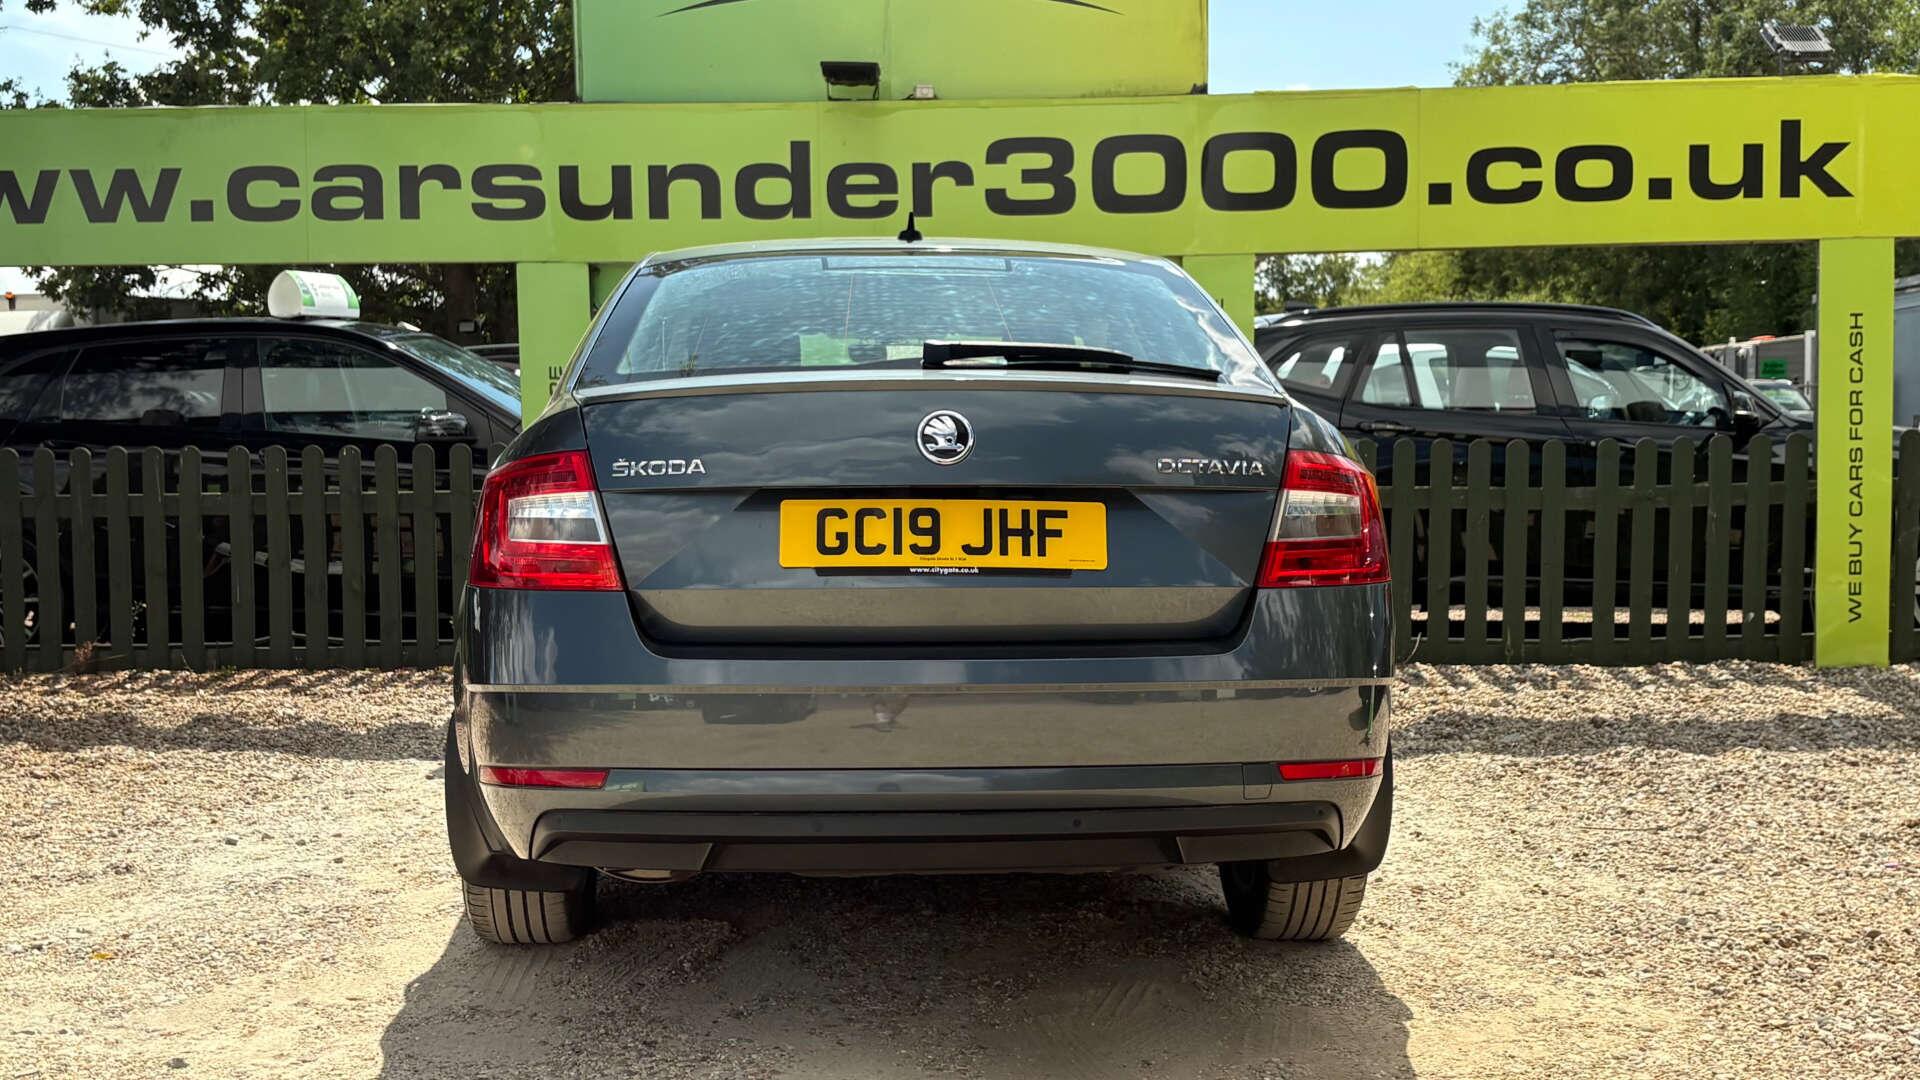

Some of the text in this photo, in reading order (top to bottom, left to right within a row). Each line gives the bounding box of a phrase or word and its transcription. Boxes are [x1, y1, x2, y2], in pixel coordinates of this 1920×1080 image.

[611, 458, 706, 477] ŠKODA
[1157, 458, 1265, 476] OCTAVIA
[1848, 312, 1864, 624] WE BUY CARS FOR CASH
[816, 507, 1069, 558] GC19 JHF
